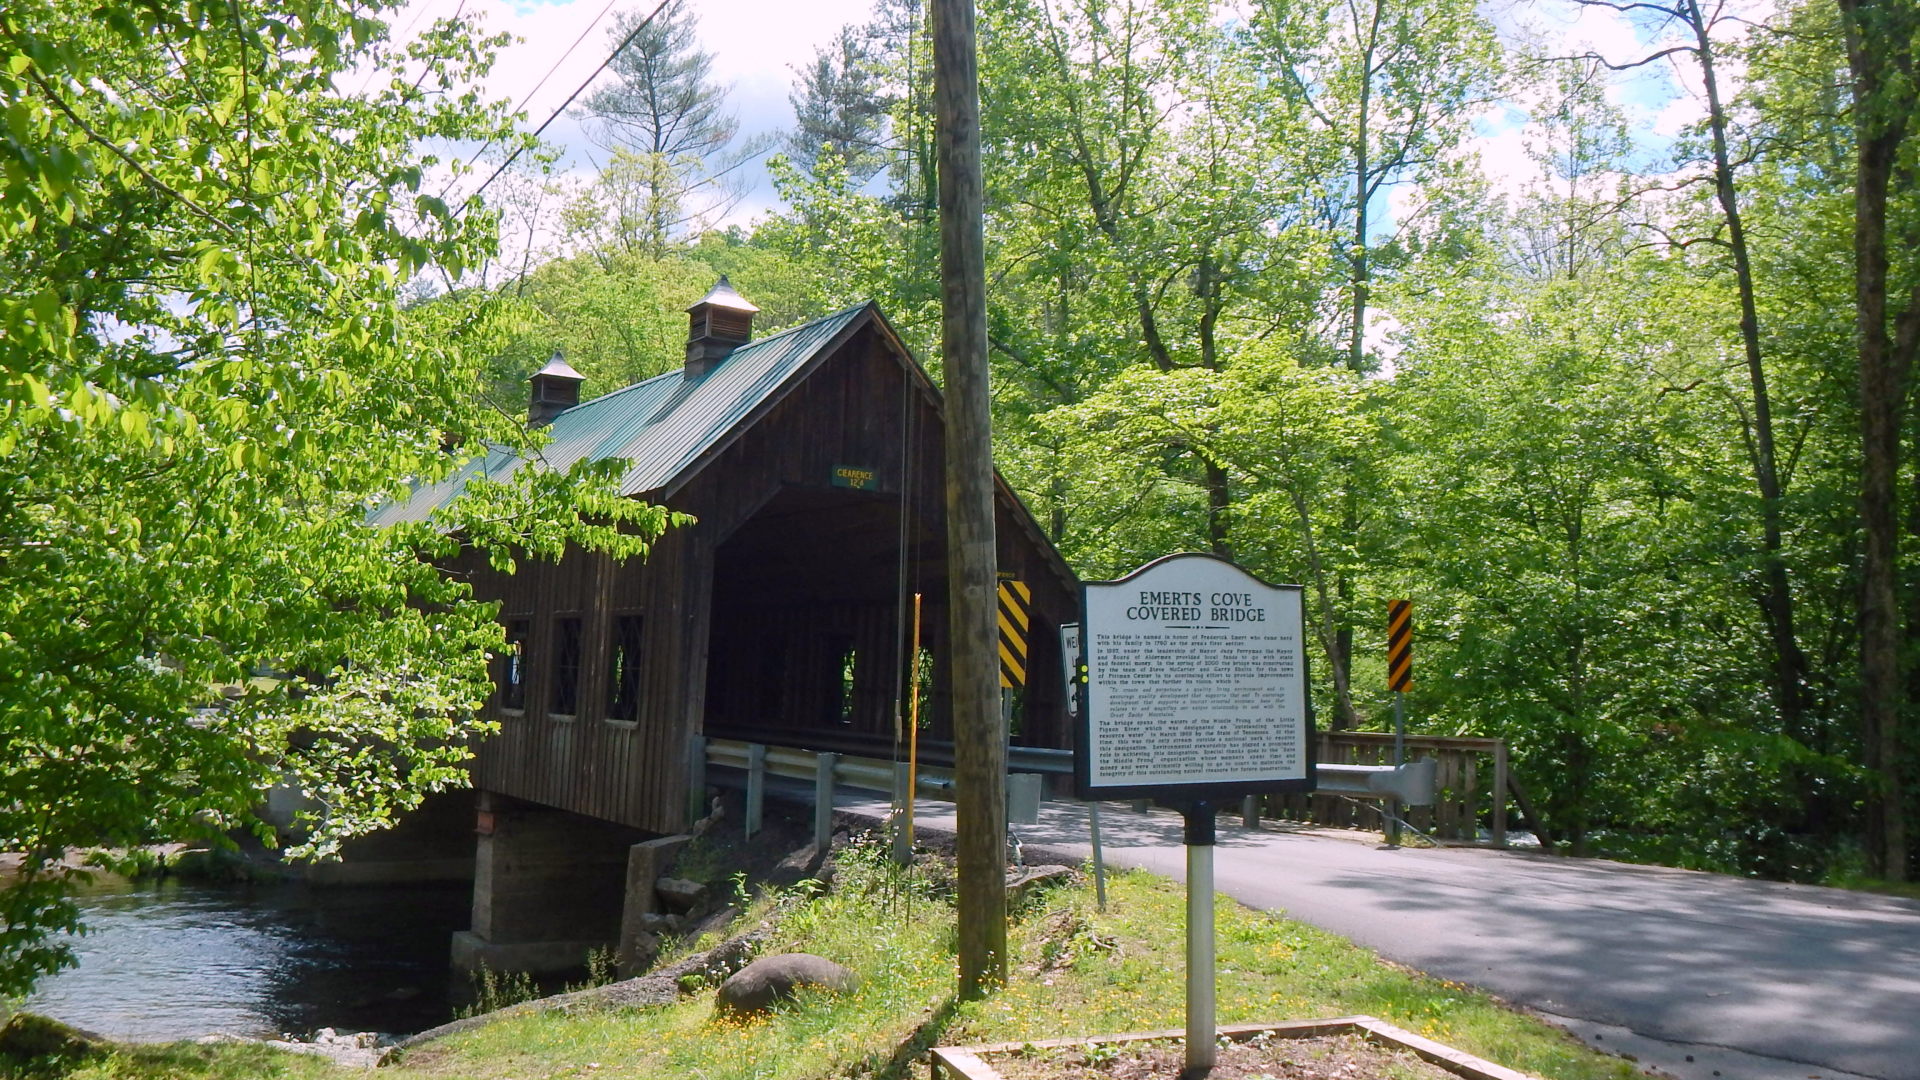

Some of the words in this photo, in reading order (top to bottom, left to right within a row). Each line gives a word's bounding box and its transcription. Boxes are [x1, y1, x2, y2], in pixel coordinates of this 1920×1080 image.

[1140, 591, 1201, 606] EMERTS
[1211, 592, 1252, 606] COVE
[1127, 606, 1201, 620] COVERED
[1211, 607, 1265, 621] BRIDGE
